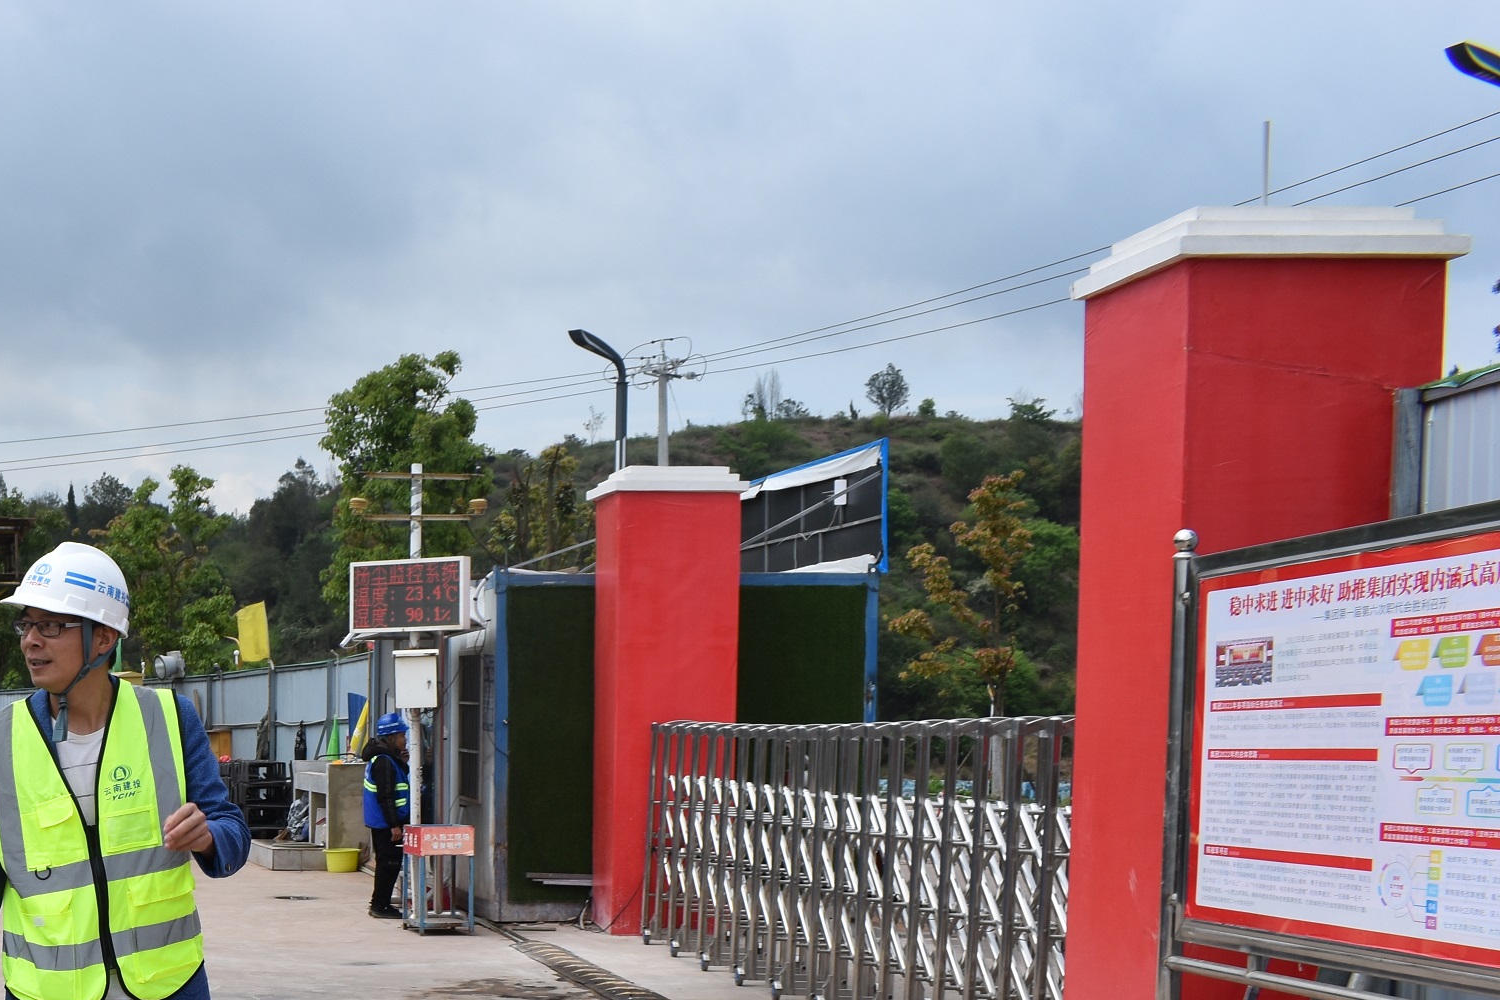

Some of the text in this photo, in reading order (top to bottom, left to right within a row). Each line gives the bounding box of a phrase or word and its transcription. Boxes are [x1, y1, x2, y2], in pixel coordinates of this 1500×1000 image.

[1229, 589, 1278, 617] 稳中求进
[1281, 583, 1334, 610] 进中求好
[104, 778, 141, 796] 云南建投
[112, 790, 136, 801] YCIH
